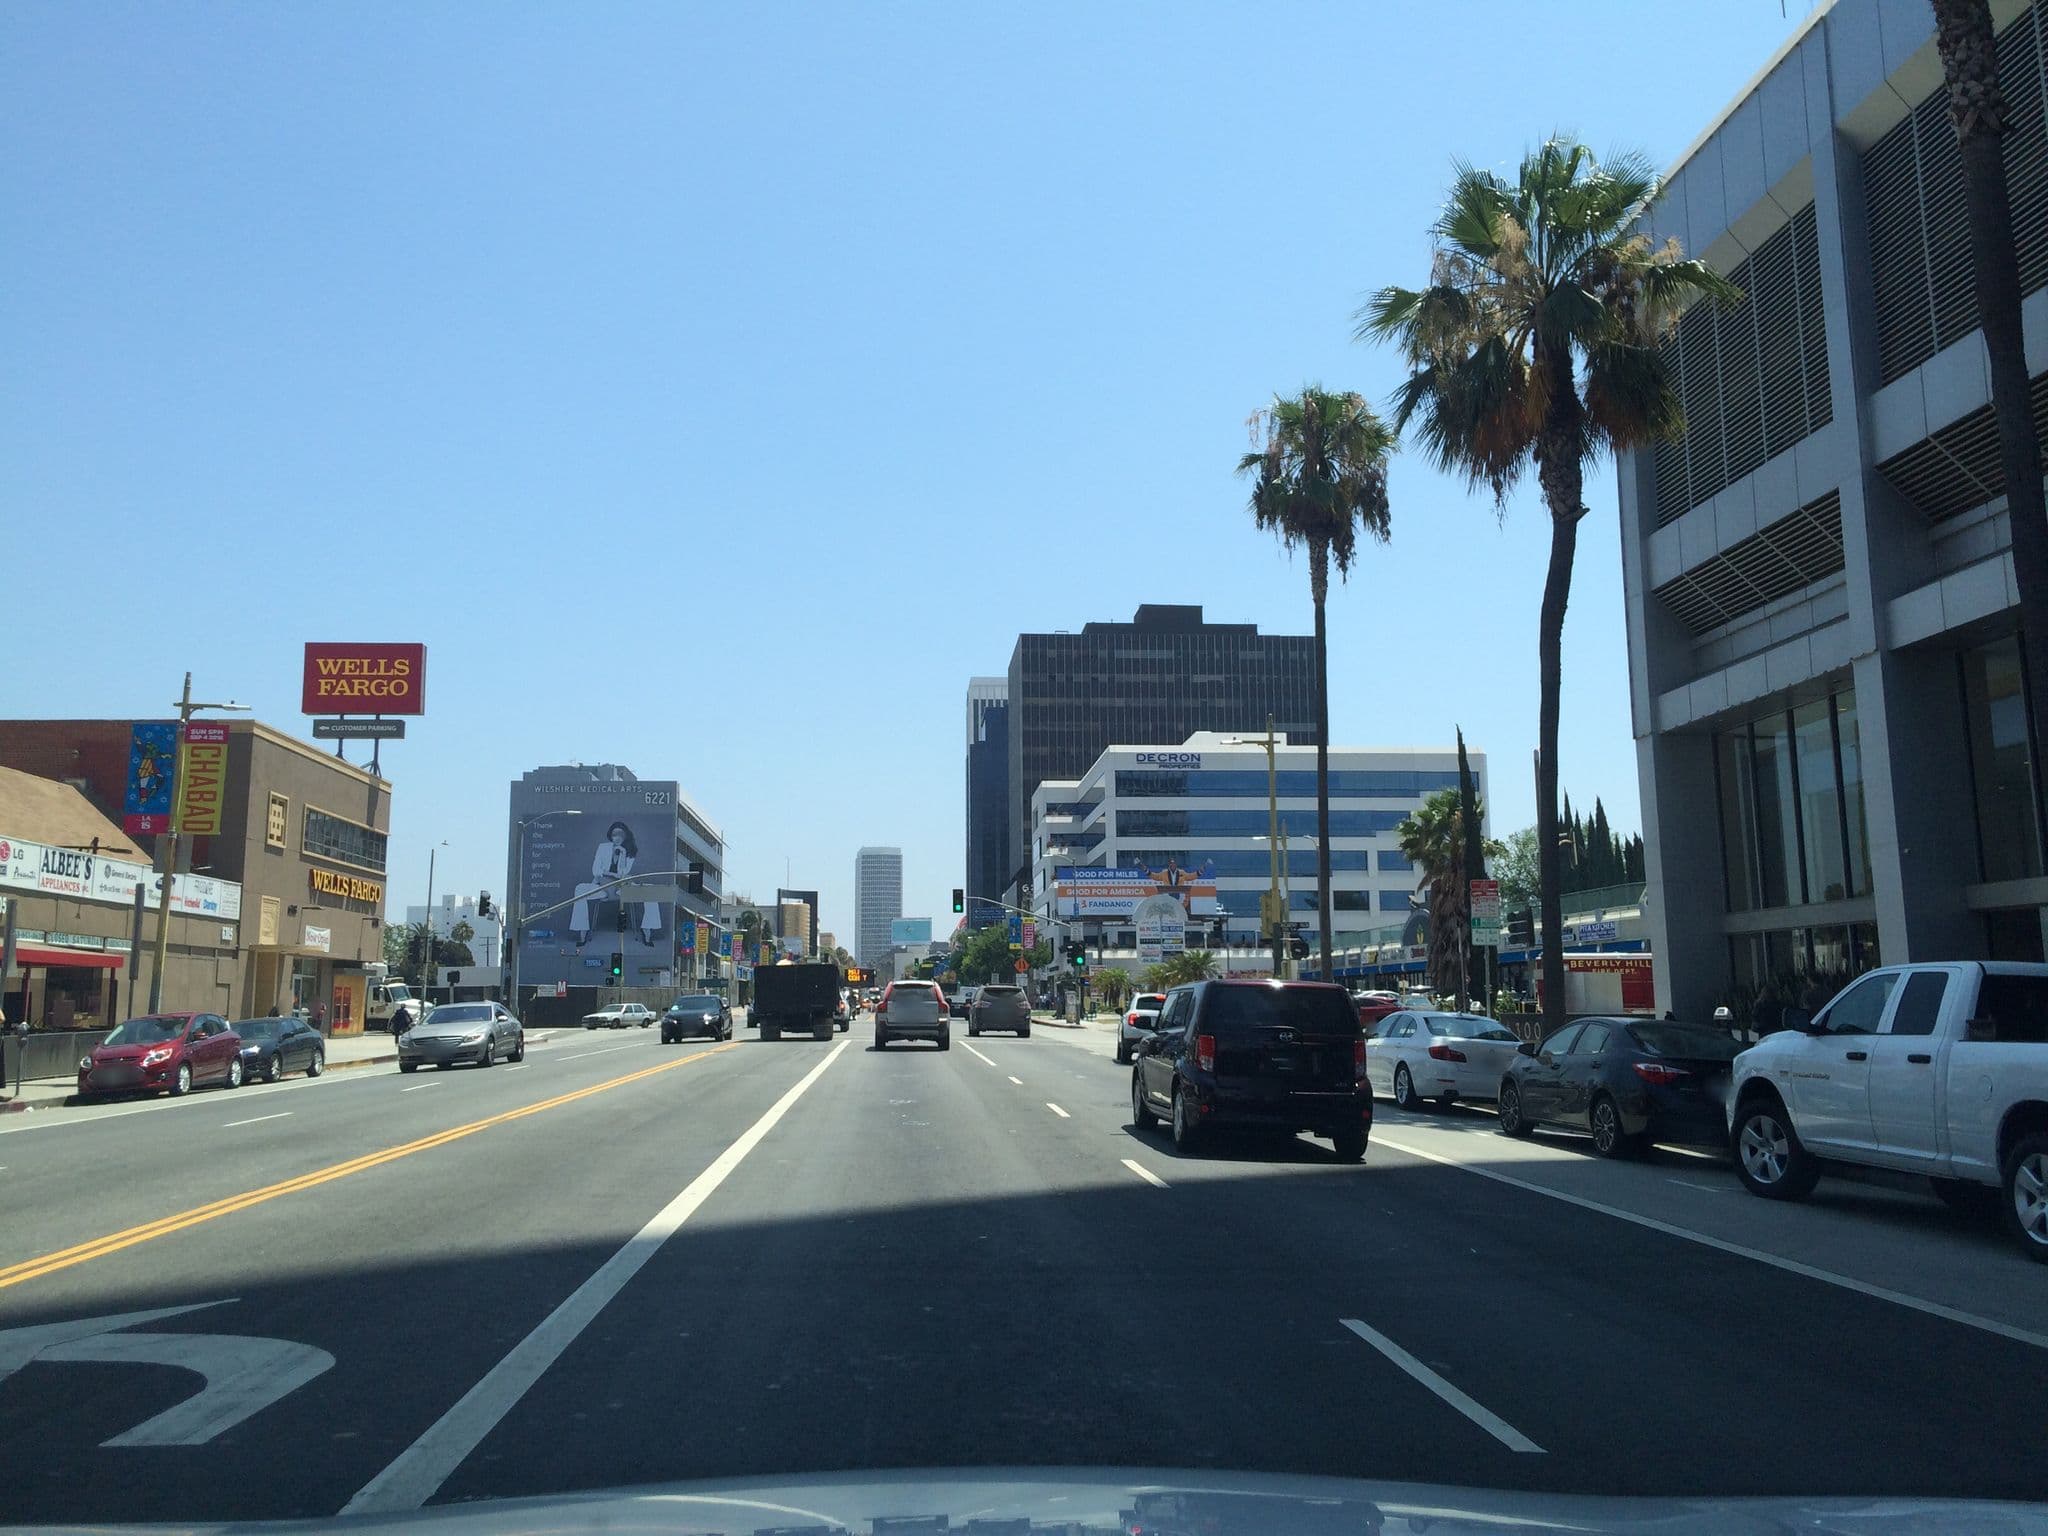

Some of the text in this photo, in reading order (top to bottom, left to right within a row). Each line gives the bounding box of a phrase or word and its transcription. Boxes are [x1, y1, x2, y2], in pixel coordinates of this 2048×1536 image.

[316, 658, 410, 676] WELLS
[317, 679, 409, 697] FARGO
[1136, 753, 1201, 762] DECRON
[183, 745, 222, 832] CHABAD
[620, 785, 642, 793] ARTS
[645, 792, 671, 805] 6221
[13, 848, 24, 860] LG
[40, 877, 80, 893] APPLIANCES
[313, 869, 382, 903] WELLS FARGO
[1066, 888, 1145, 896] GOOD FOR AMERICA
[1570, 960, 1652, 968] BEVERLY HILL
[557, 980, 567, 993] M
